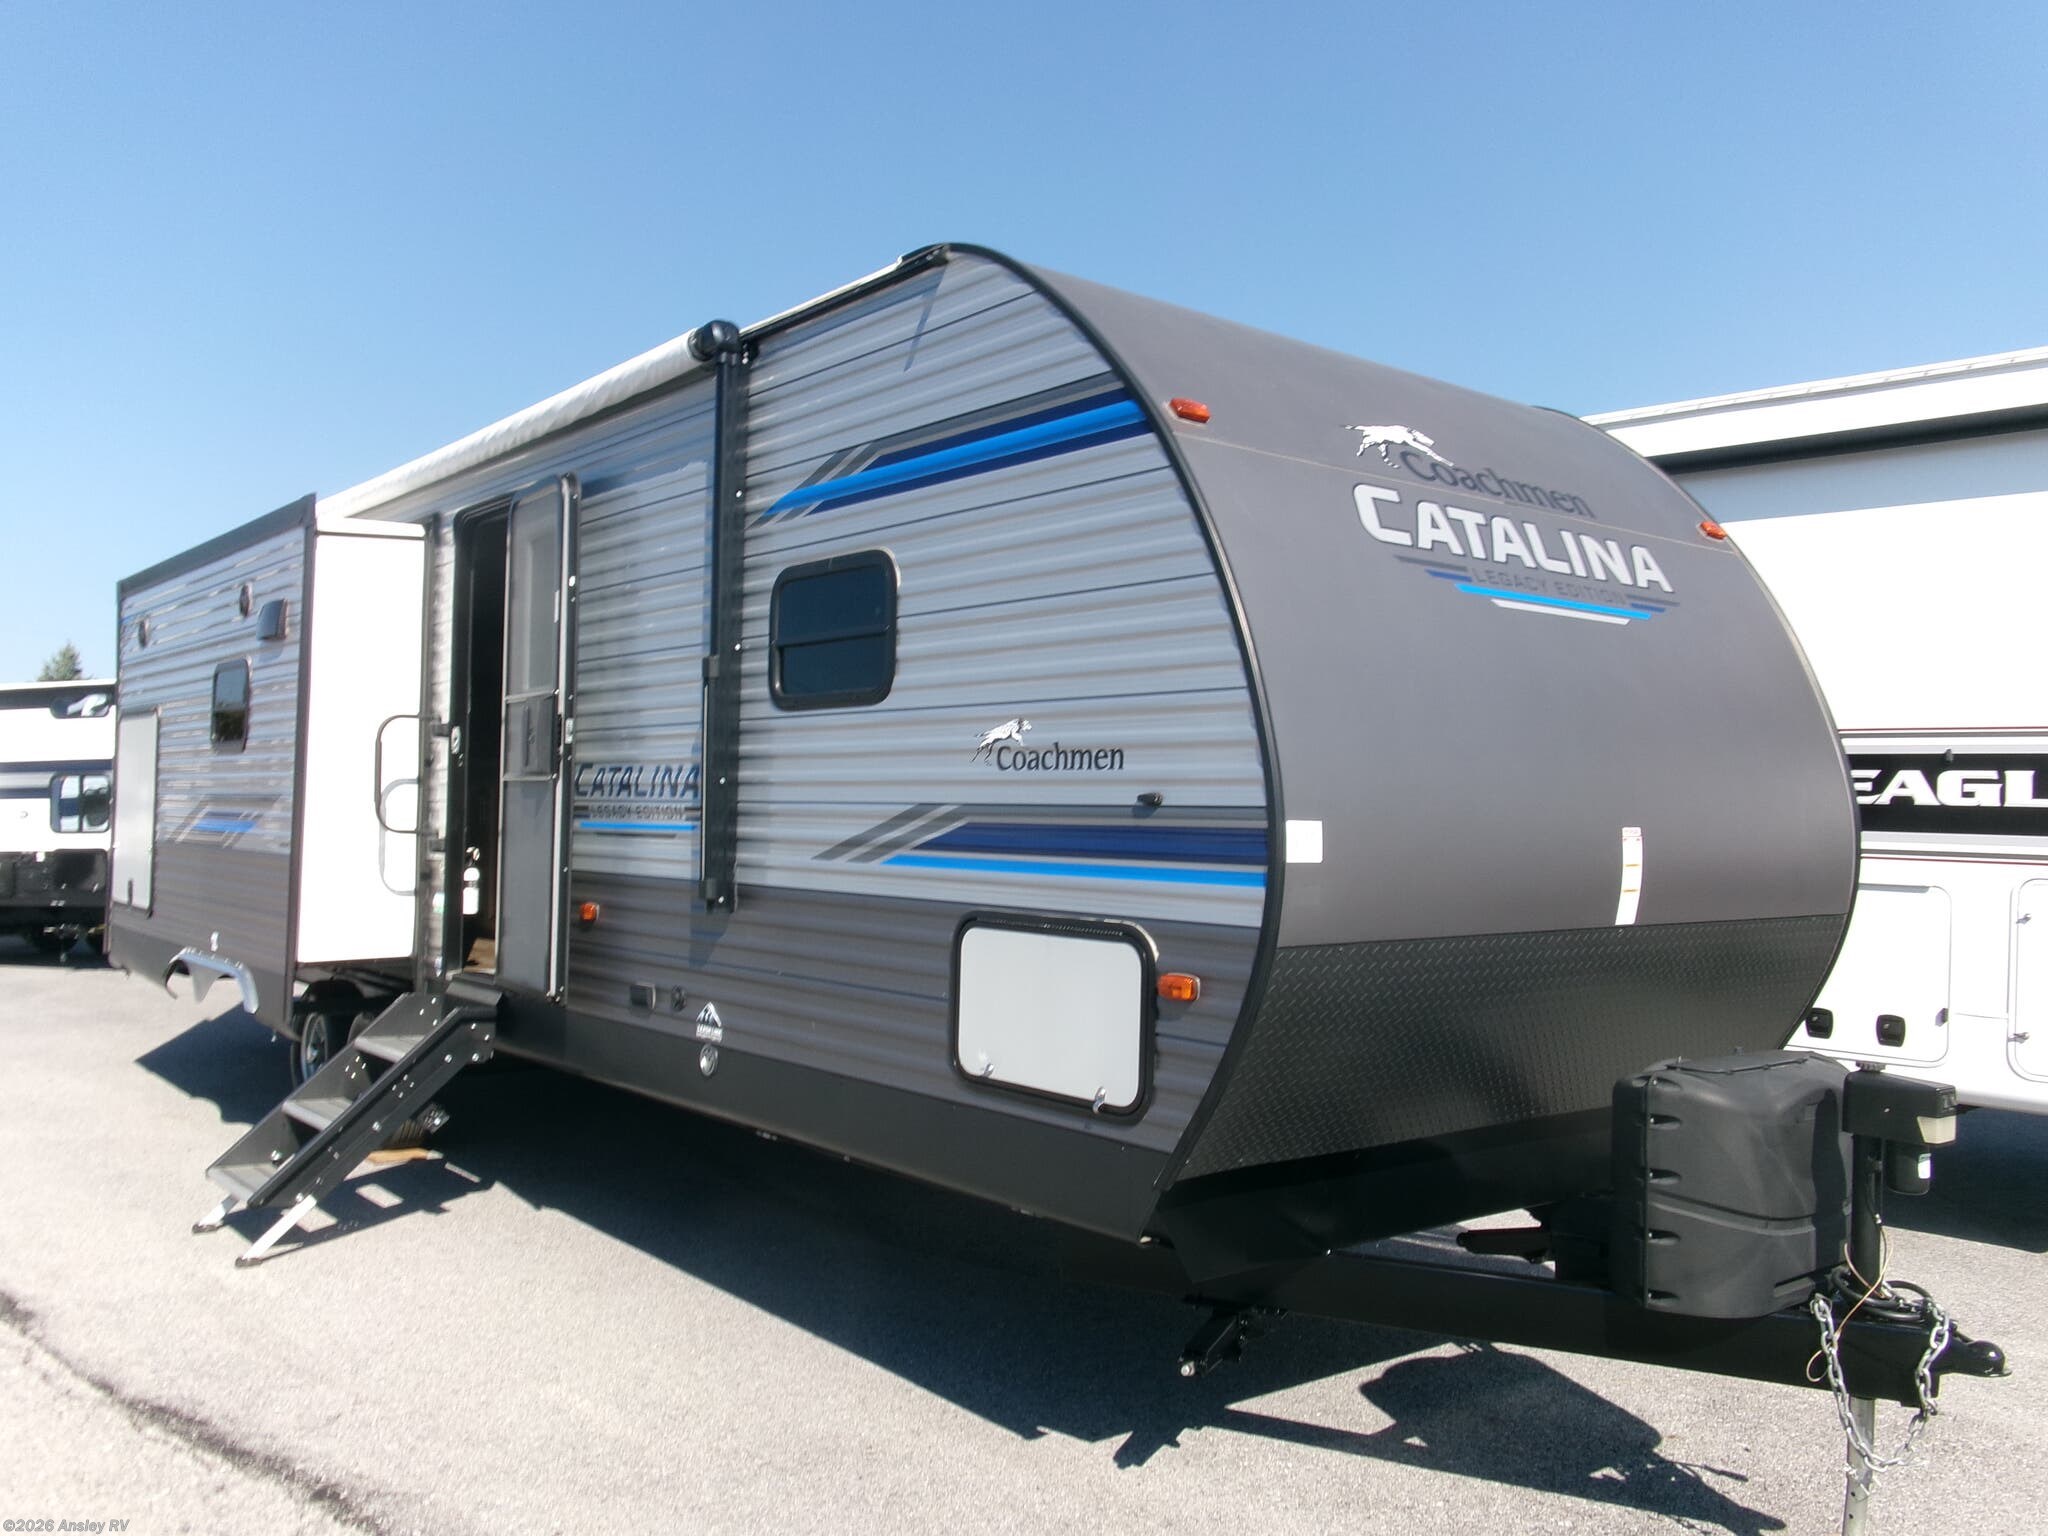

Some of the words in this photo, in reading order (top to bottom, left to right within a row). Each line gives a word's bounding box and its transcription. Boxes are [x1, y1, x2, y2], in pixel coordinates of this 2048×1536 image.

[1400, 449, 1596, 519] Coachmen
[1353, 483, 1675, 593] CATALINA
[1472, 566, 1548, 592] LEGACY
[1553, 581, 1628, 606] EDITION
[996, 742, 1124, 771] Coachmen
[575, 762, 700, 799] CATALINA
